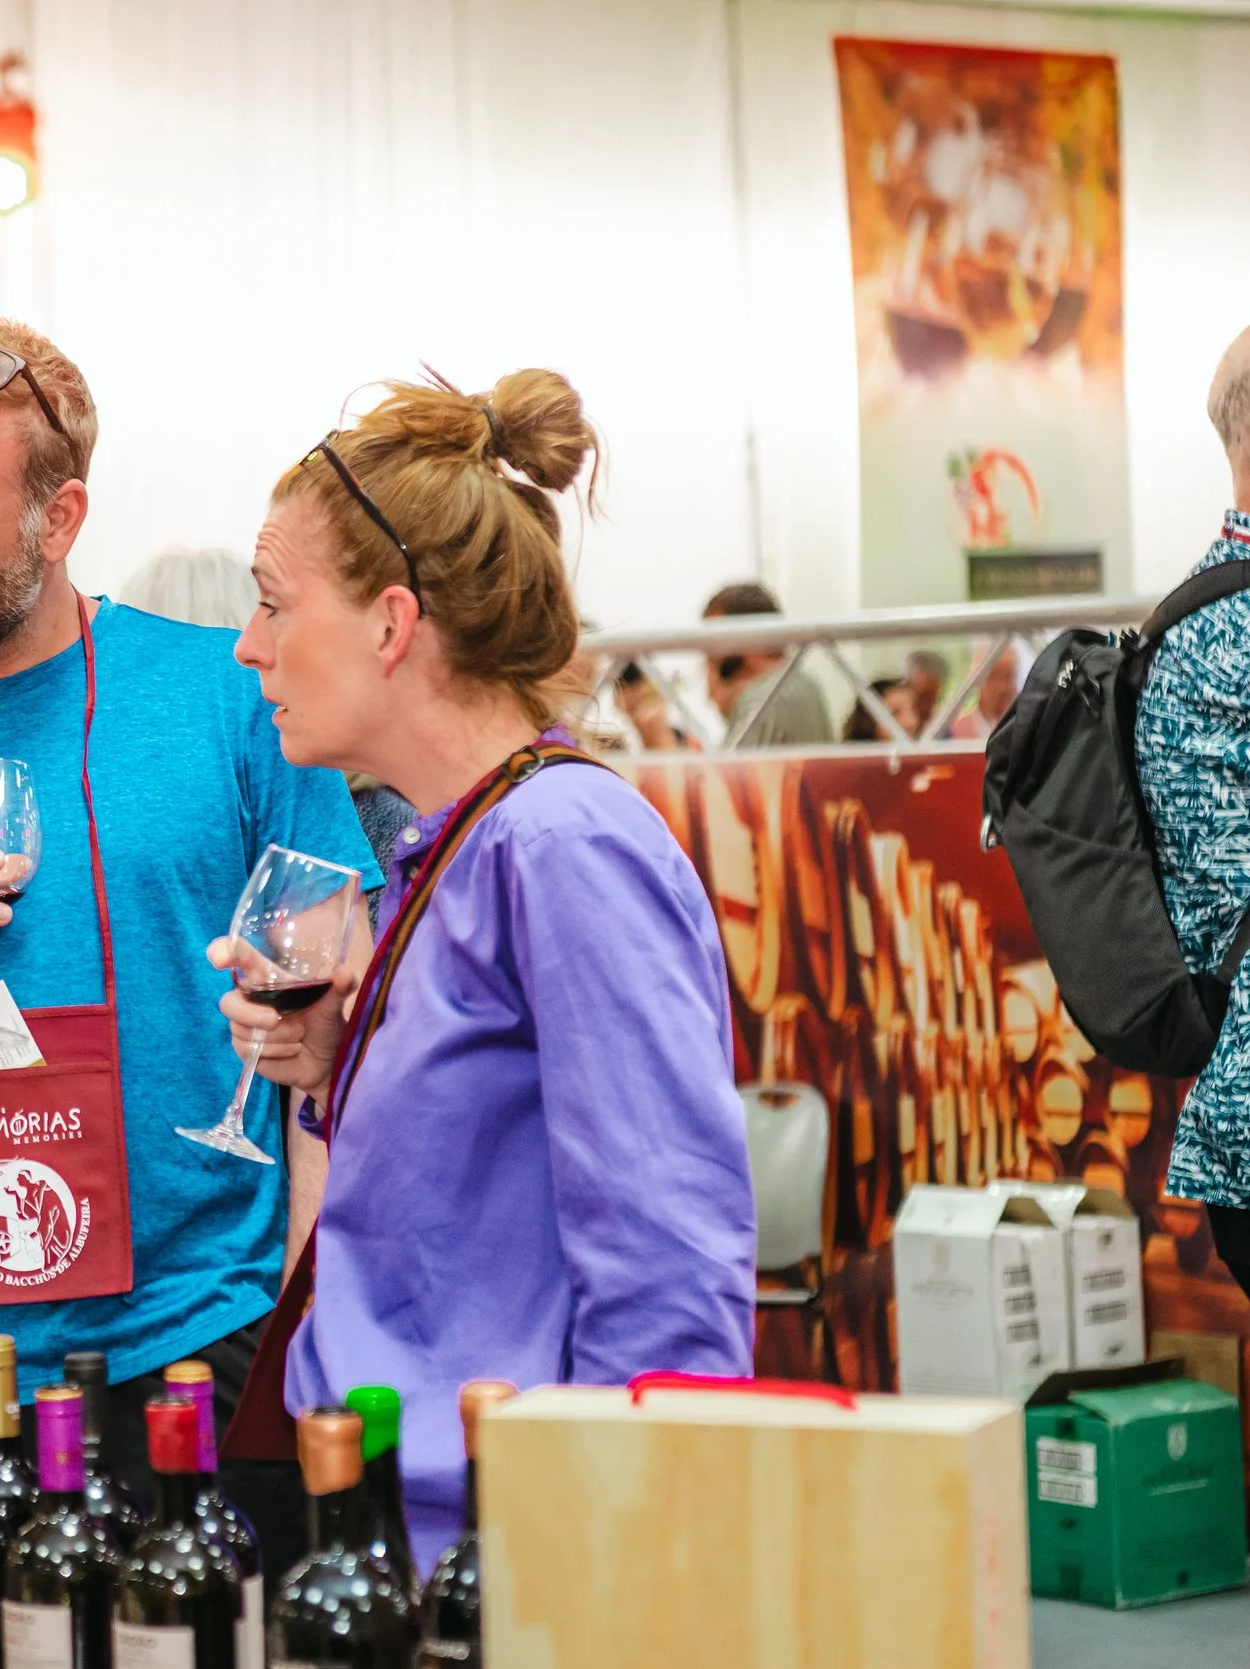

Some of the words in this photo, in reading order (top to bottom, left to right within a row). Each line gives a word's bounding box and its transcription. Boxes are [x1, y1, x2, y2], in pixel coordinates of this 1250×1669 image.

[13, 1131, 83, 1145] MEMORIES
[5, 1269, 57, 1287] BACCHUS
[55, 1258, 72, 1274] DE
[68, 1197, 91, 1262] ALBUFEIRA
